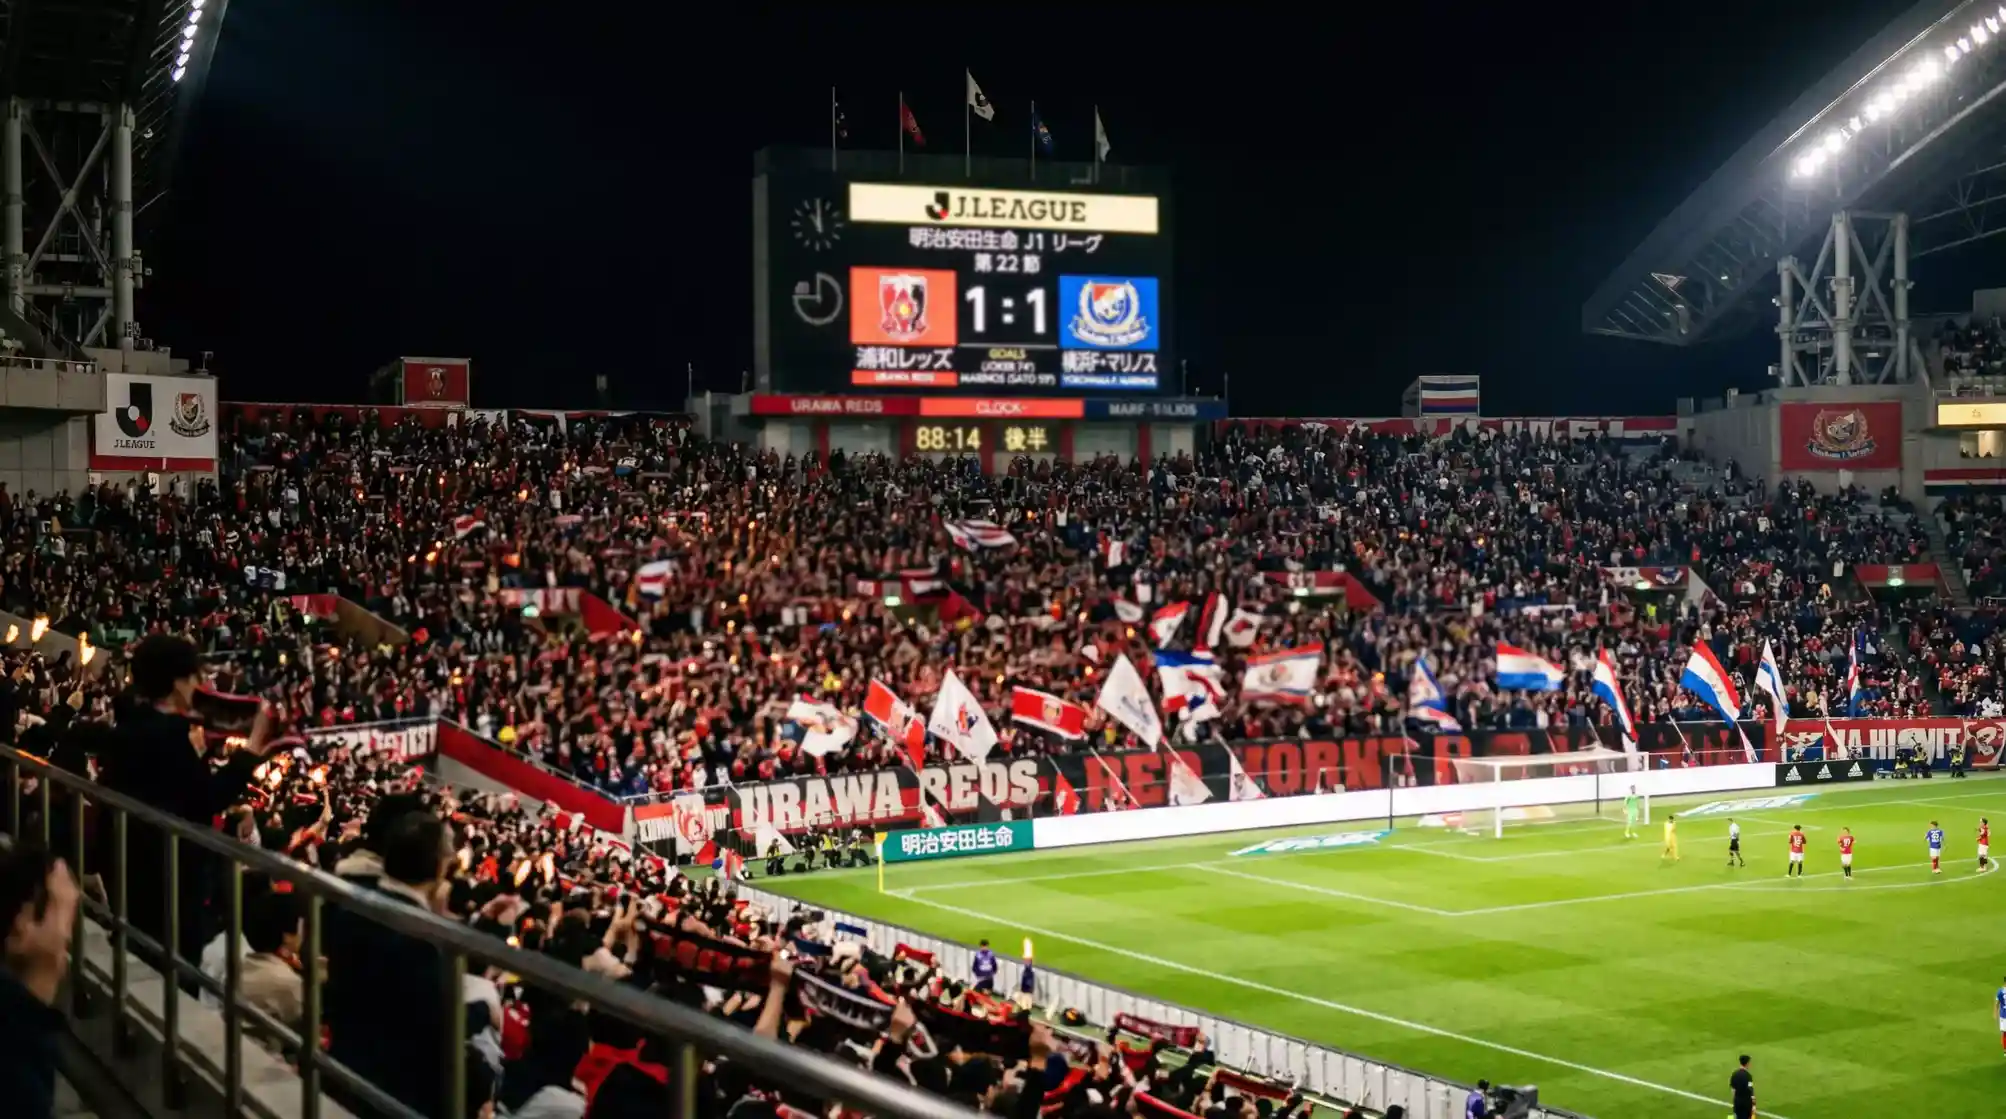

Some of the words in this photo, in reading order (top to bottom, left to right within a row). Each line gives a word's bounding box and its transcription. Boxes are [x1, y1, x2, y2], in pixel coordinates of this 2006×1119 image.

[953, 196, 1087, 223] J.LEAGUE
[909, 227, 1018, 250] 明治安田生命
[1024, 232, 1044, 251] J1
[996, 254, 1019, 272] 22
[856, 346, 955, 370] 浦和レッズ
[791, 400, 842, 413] URAWA
[845, 400, 884, 414] REDS
[916, 425, 981, 450] 88:14
[1004, 426, 1048, 451] 後半
[738, 769, 904, 834] URAWA
[918, 759, 1040, 813] REDS
[901, 825, 1014, 855] 明治安田生命
